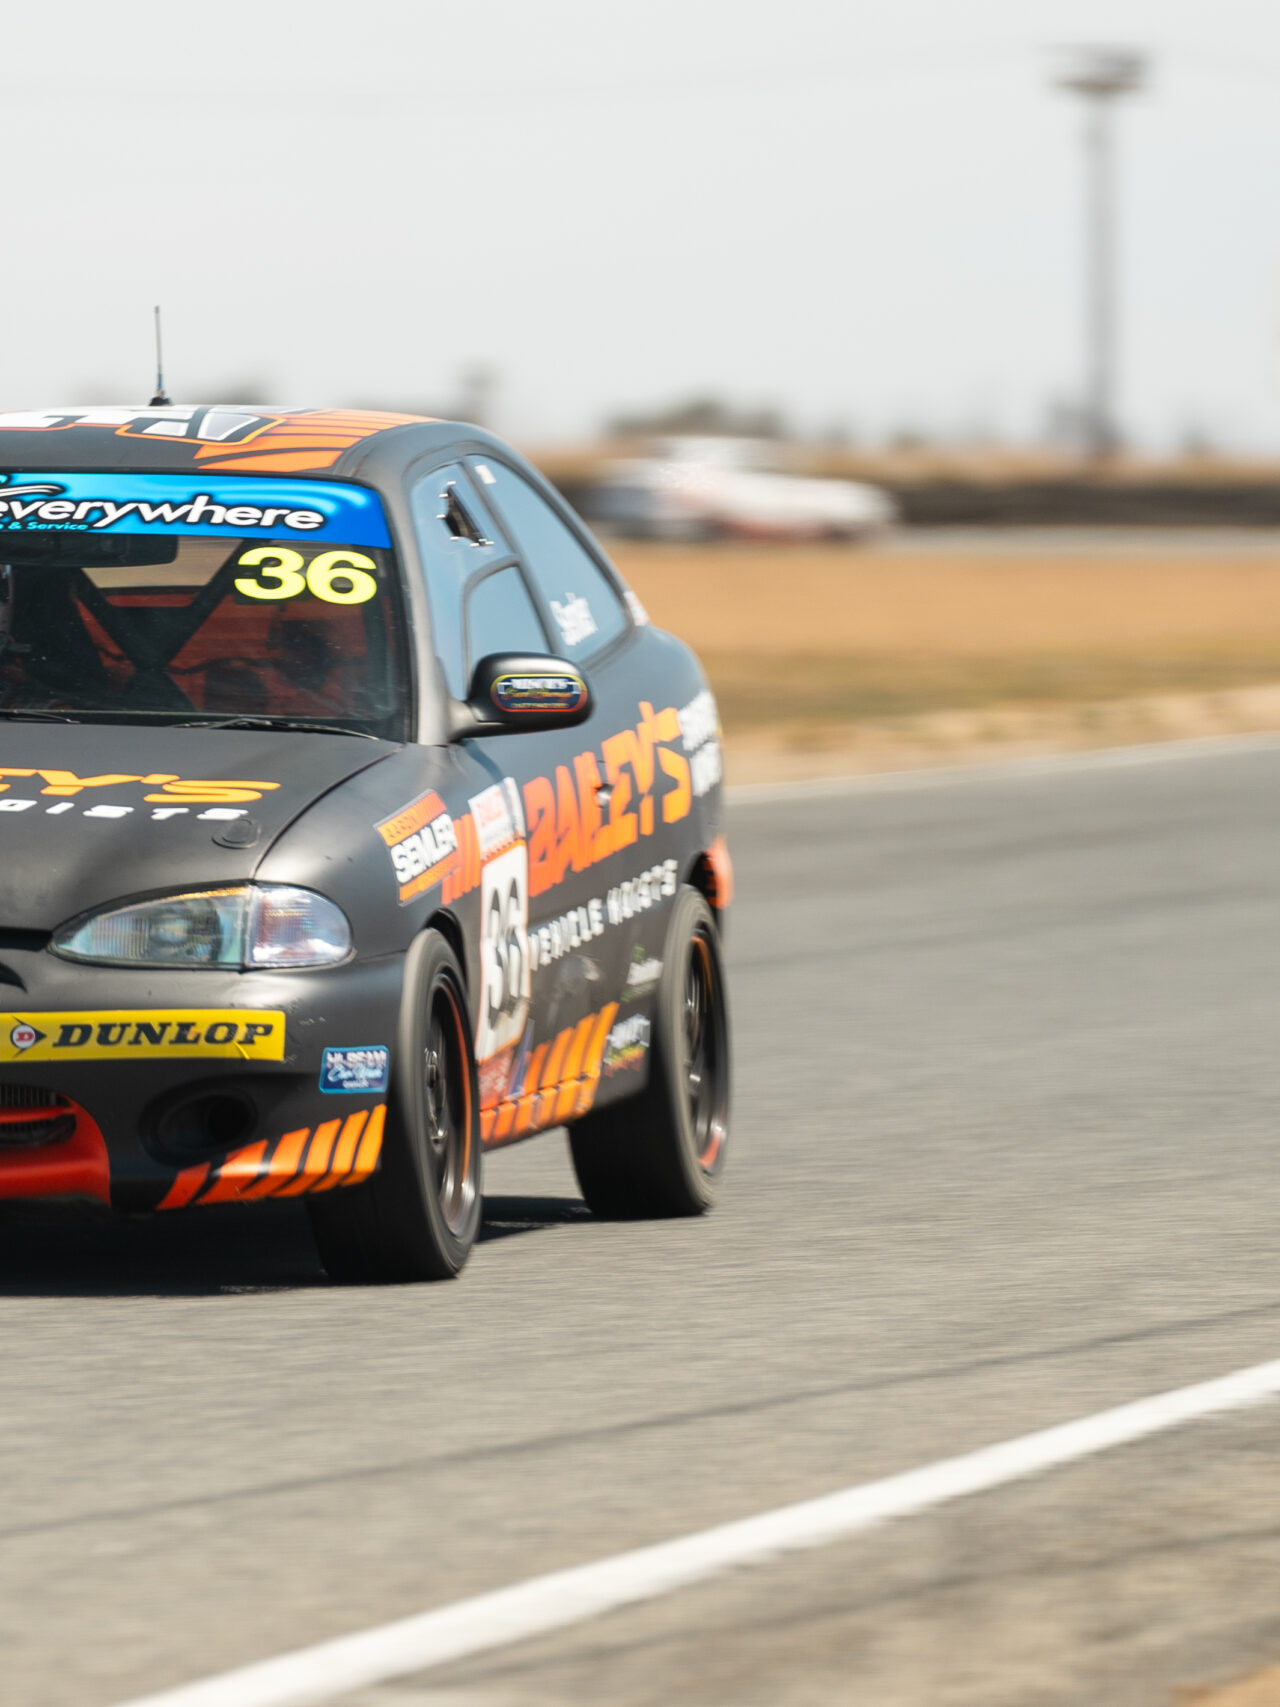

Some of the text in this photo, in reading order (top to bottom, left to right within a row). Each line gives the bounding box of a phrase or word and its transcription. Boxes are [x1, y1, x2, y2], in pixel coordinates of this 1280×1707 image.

[7, 521, 22, 531] &
[26, 521, 89, 531] Service
[233, 546, 378, 606] 36
[51, 1021, 275, 1048] DUNLOP
